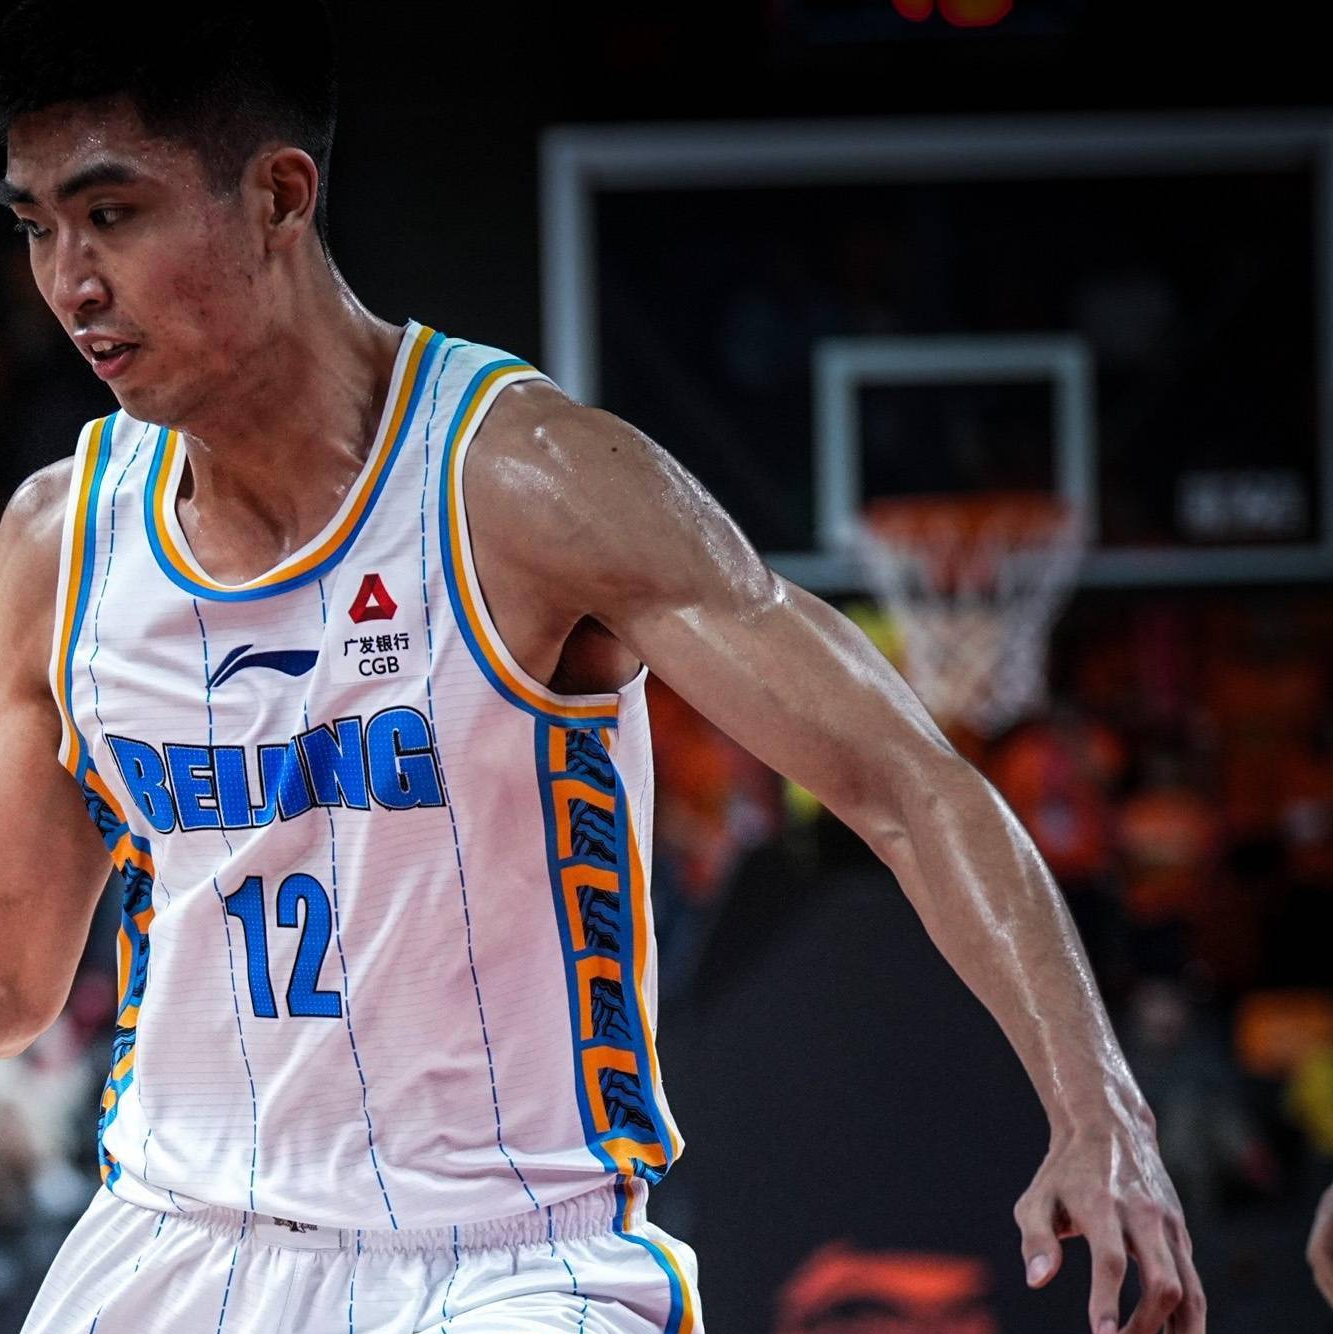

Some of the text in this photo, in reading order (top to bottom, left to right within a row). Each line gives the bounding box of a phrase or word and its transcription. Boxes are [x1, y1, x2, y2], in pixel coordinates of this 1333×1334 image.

[343, 632, 410, 657] 广发银行
[358, 656, 400, 676] CGB
[103, 706, 446, 835] BEIJING
[224, 873, 343, 1020] 12
